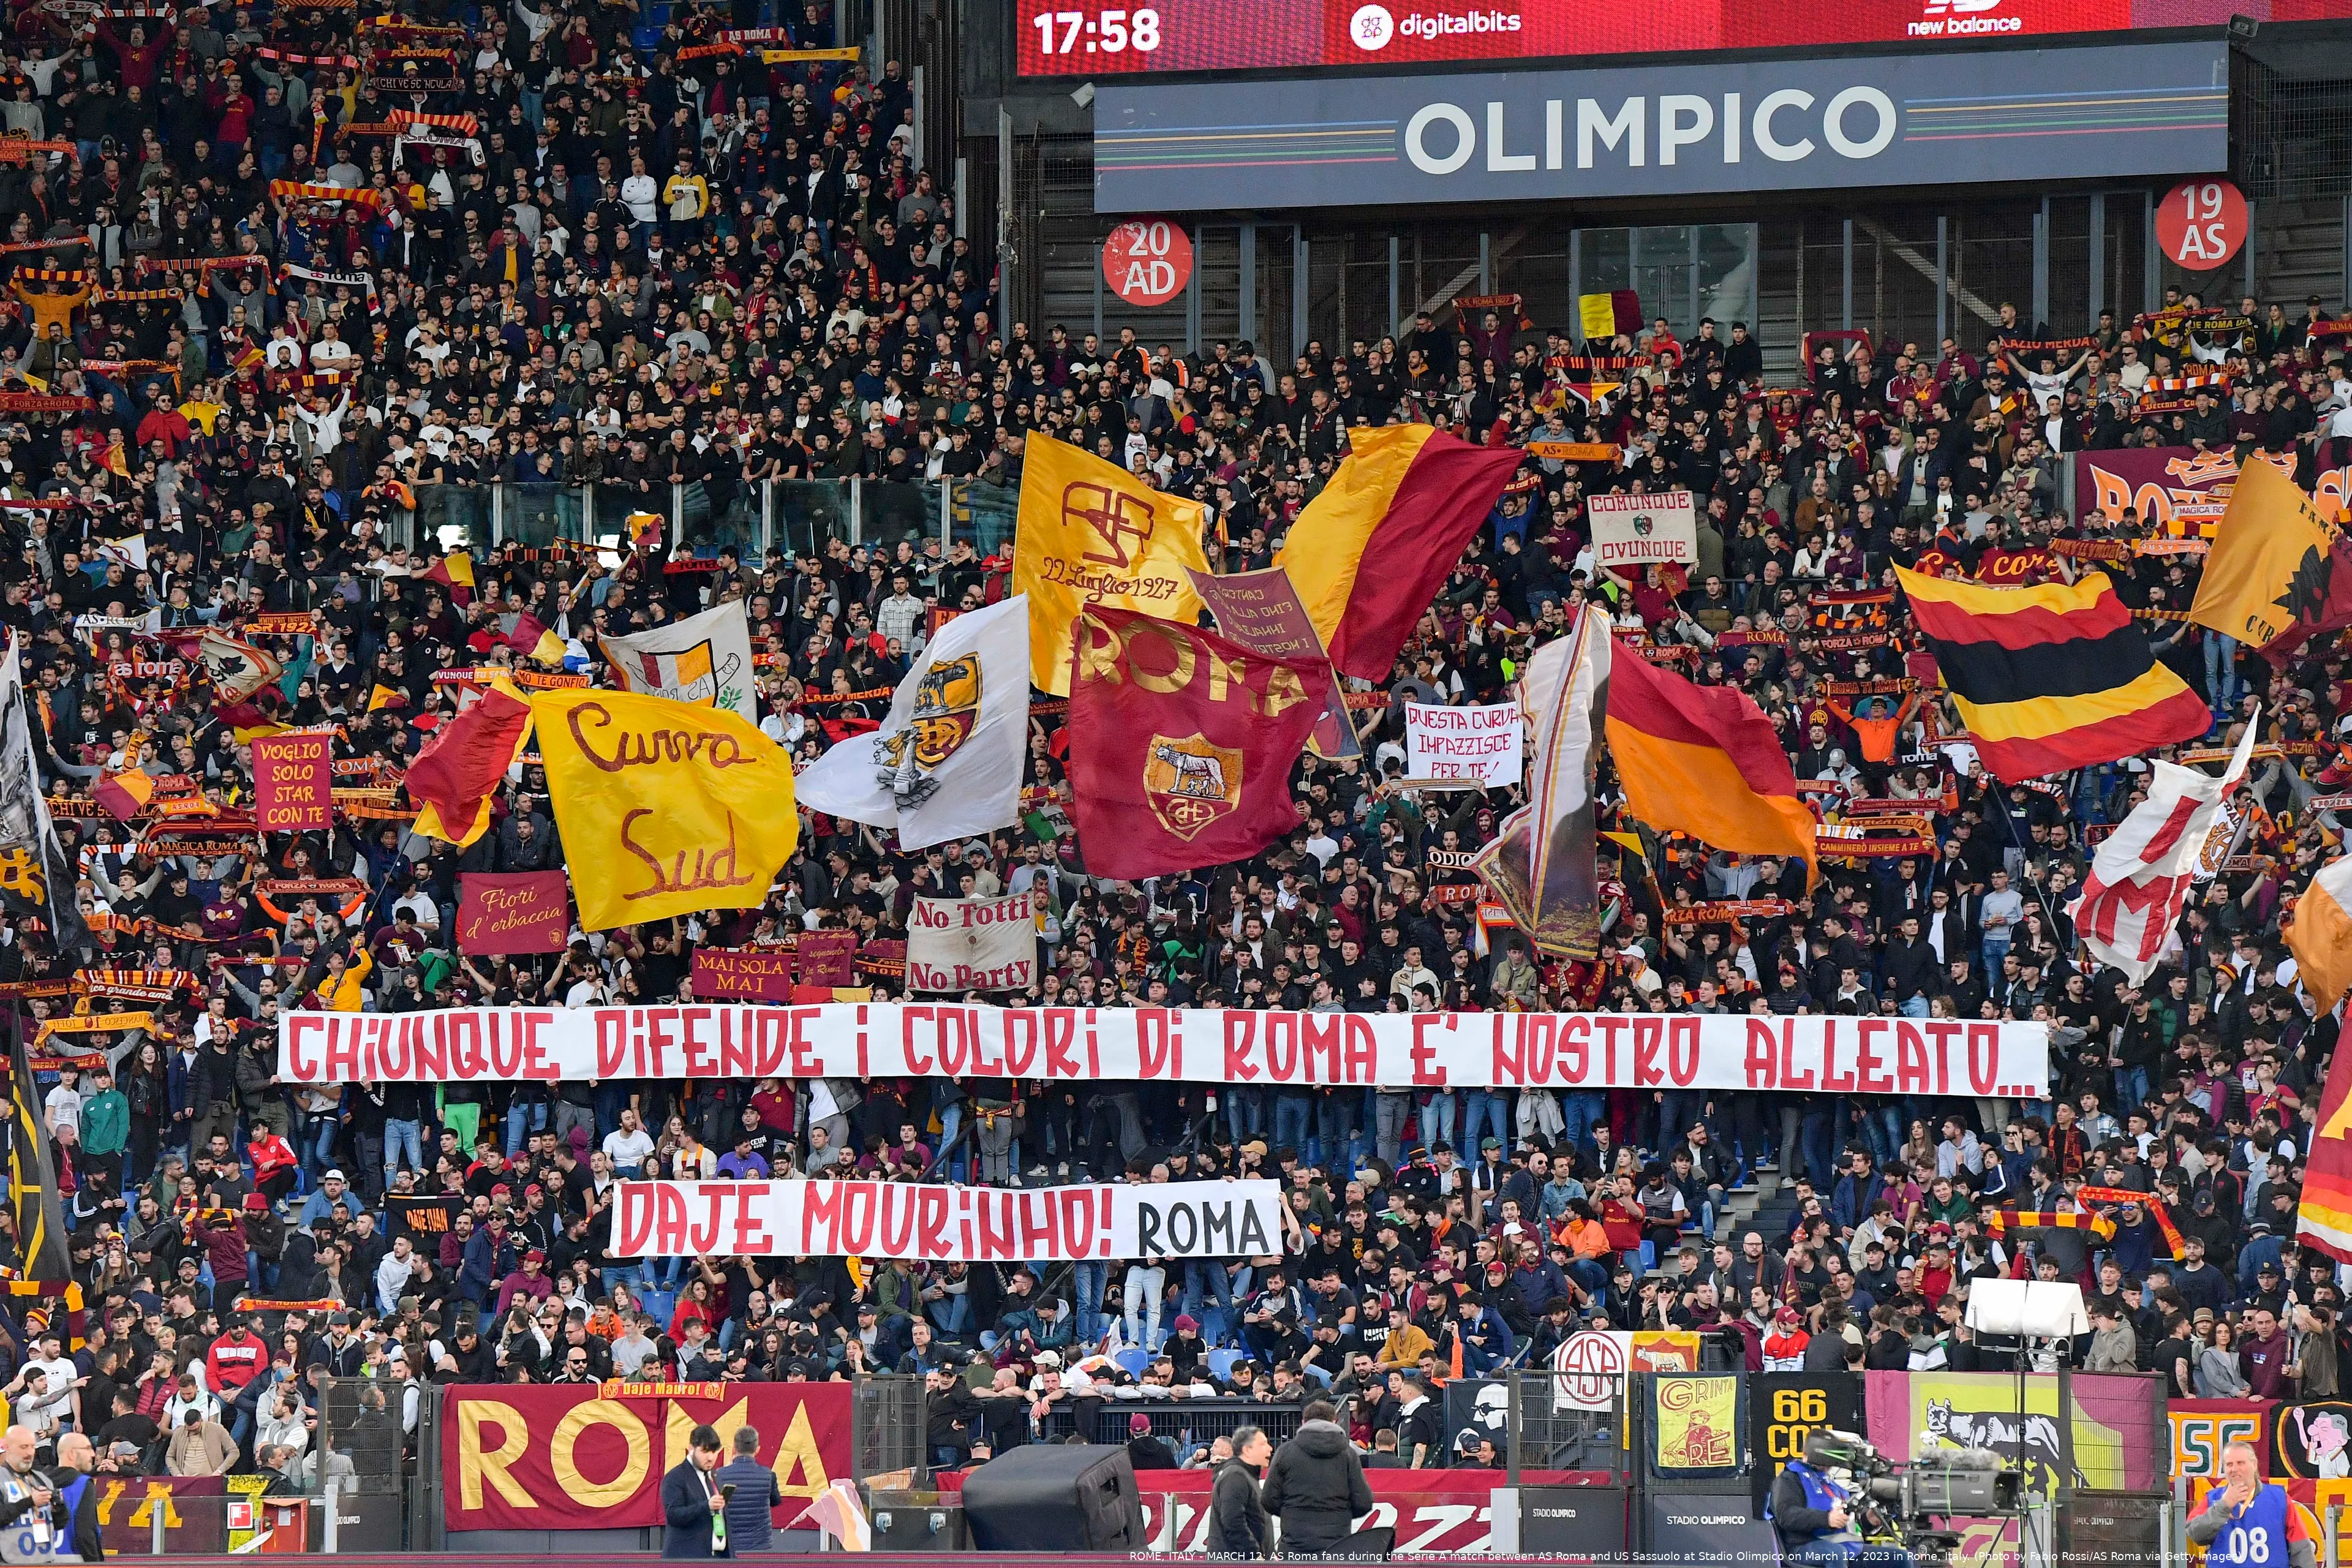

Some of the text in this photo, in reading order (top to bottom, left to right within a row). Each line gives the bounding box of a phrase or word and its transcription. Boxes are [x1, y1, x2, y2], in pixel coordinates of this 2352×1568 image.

[1033, 8, 1161, 55] 17:58
[1400, 11, 1521, 39] digitalbits
[1907, 16, 2022, 36] new balance
[729, 29, 772, 41] AS ROMA
[380, 78, 421, 89] CHI VE SE
[1404, 85, 1897, 175] OLIMPICO
[2180, 183, 2223, 220] 19
[39, 236, 79, 247] Roma
[1128, 221, 1170, 256] 20
[2178, 224, 2226, 261] AS
[328, 273, 365, 283] roma
[1123, 261, 1176, 296] AD
[2002, 336, 2090, 349] LAZIO MERDA
[2185, 364, 2215, 376] ROMA
[50, 399, 76, 408] ROMA
[1542, 445, 1596, 456] AS ROMA
[1591, 492, 1690, 512] COMUNQUE
[2179, 506, 2210, 515] MAGICA
[1602, 540, 1686, 561] OVUNQUE
[1041, 557, 1178, 605] 22 Luglio 1927
[1746, 630, 1785, 643] ROMA
[1820, 633, 1888, 648] FORZA ROMA
[1656, 647, 1681, 657] ROMA
[114, 661, 183, 676] as roma
[537, 676, 547, 685] TE
[1829, 679, 1899, 694] ROMA TI AMO
[846, 687, 890, 701] MERDA
[1408, 707, 1520, 730] QUESTA CURVA
[307, 723, 338, 734] ROMA
[566, 701, 757, 772] Curva
[259, 742, 322, 761] VOGLIO
[1901, 753, 1938, 764] roma
[271, 763, 315, 782] SOLO
[157, 778, 186, 787] ROMA
[274, 785, 315, 804] STAR
[52, 802, 94, 817] CHI VE
[267, 805, 325, 825] CON TE
[162, 840, 238, 851] MAGICA ROMA
[620, 809, 755, 901] Sud
[1820, 840, 1919, 852] CAMMINERÒ INSIEME A TE
[480, 886, 538, 913] Fiori
[914, 895, 1030, 929] No Totti
[1697, 907, 1736, 921] ROMA
[698, 954, 784, 976] MAI SOLA
[716, 973, 763, 993] MAI
[909, 959, 1031, 992] No Party
[107, 986, 148, 997] grande
[1223, 1009, 1377, 1083] ROMA
[1410, 1014, 1459, 1087] E'
[1492, 1013, 1702, 1087] NOSTRO
[1744, 1018, 2035, 1097] ALLEATO...
[619, 1183, 774, 1256] DAJE
[1137, 1199, 1269, 1257] ROMA
[1363, 1327, 1389, 1341] NIKE
[622, 1382, 702, 1398] Daje Mauro!
[1659, 1378, 1733, 1411] GRINTA
[1772, 1389, 1827, 1422] 66
[458, 1395, 831, 1512] ROMA
[1667, 1431, 1733, 1467] CORE
[347, 1515, 361, 1525] OLIMPICO
[1532, 1509, 1576, 1518] STADIO OLIMPICO
[1667, 1515, 1746, 1525] STADIO OLIMPICO
[2229, 1526, 2269, 1565] 08
